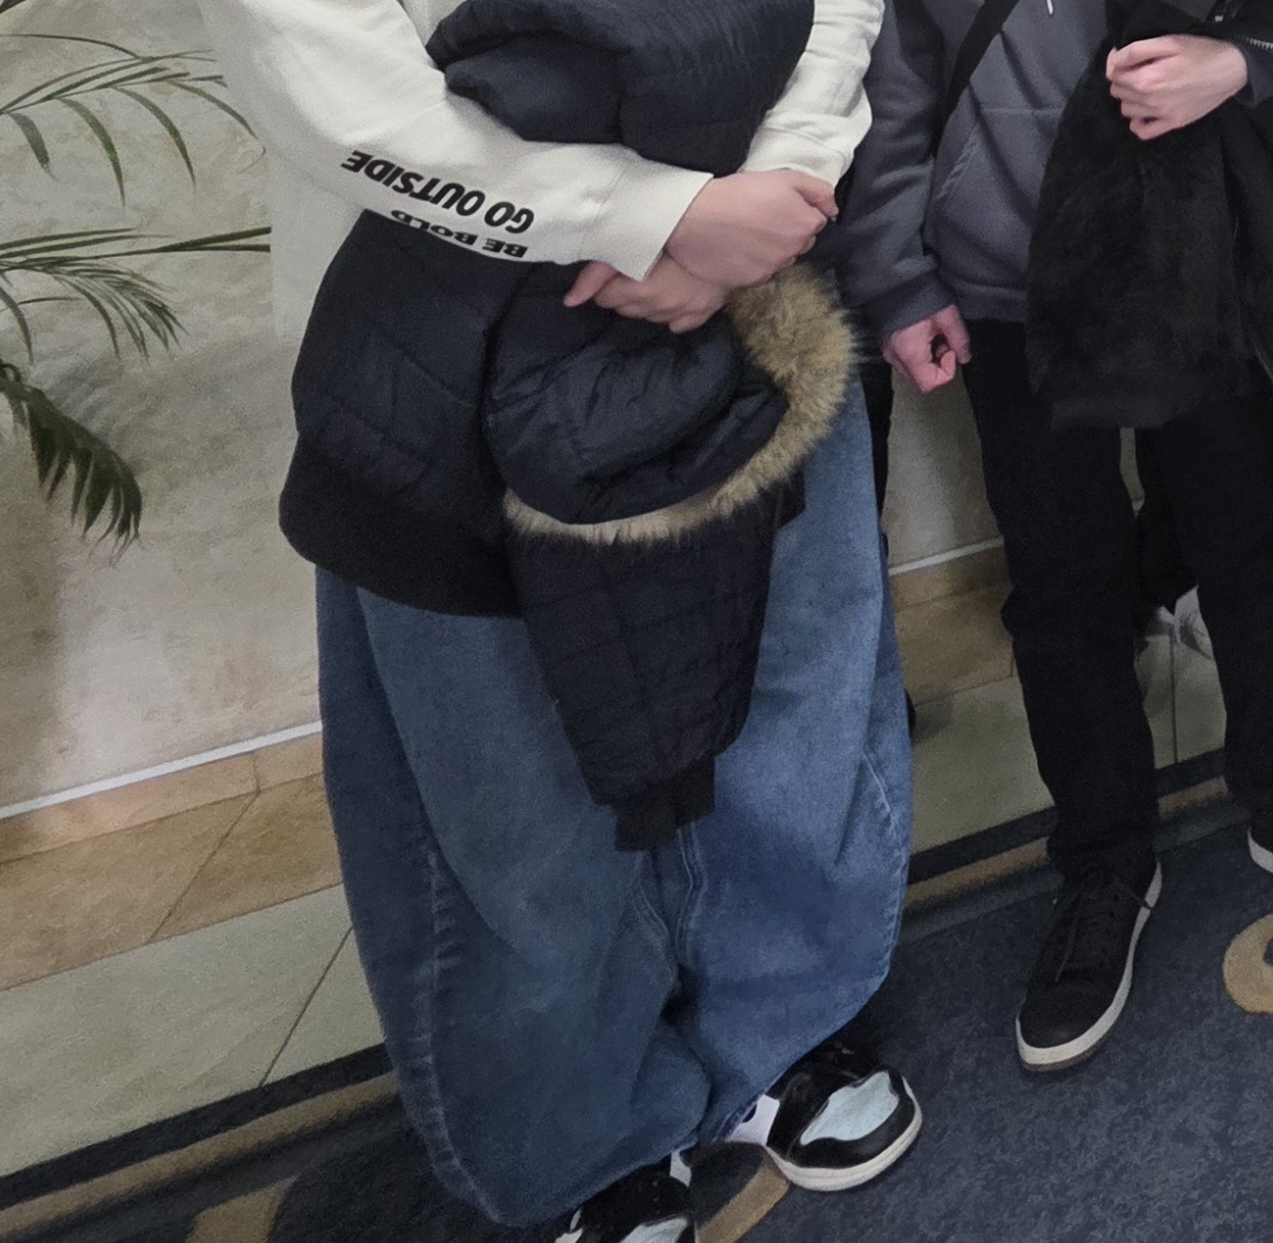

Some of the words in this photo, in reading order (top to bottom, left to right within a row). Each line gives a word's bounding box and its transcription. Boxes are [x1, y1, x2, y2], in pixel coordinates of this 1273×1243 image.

[340, 150, 486, 217] OUTSIDE
[391, 210, 478, 246] BOLD
[484, 202, 535, 234] GO
[482, 238, 529, 258] BE
